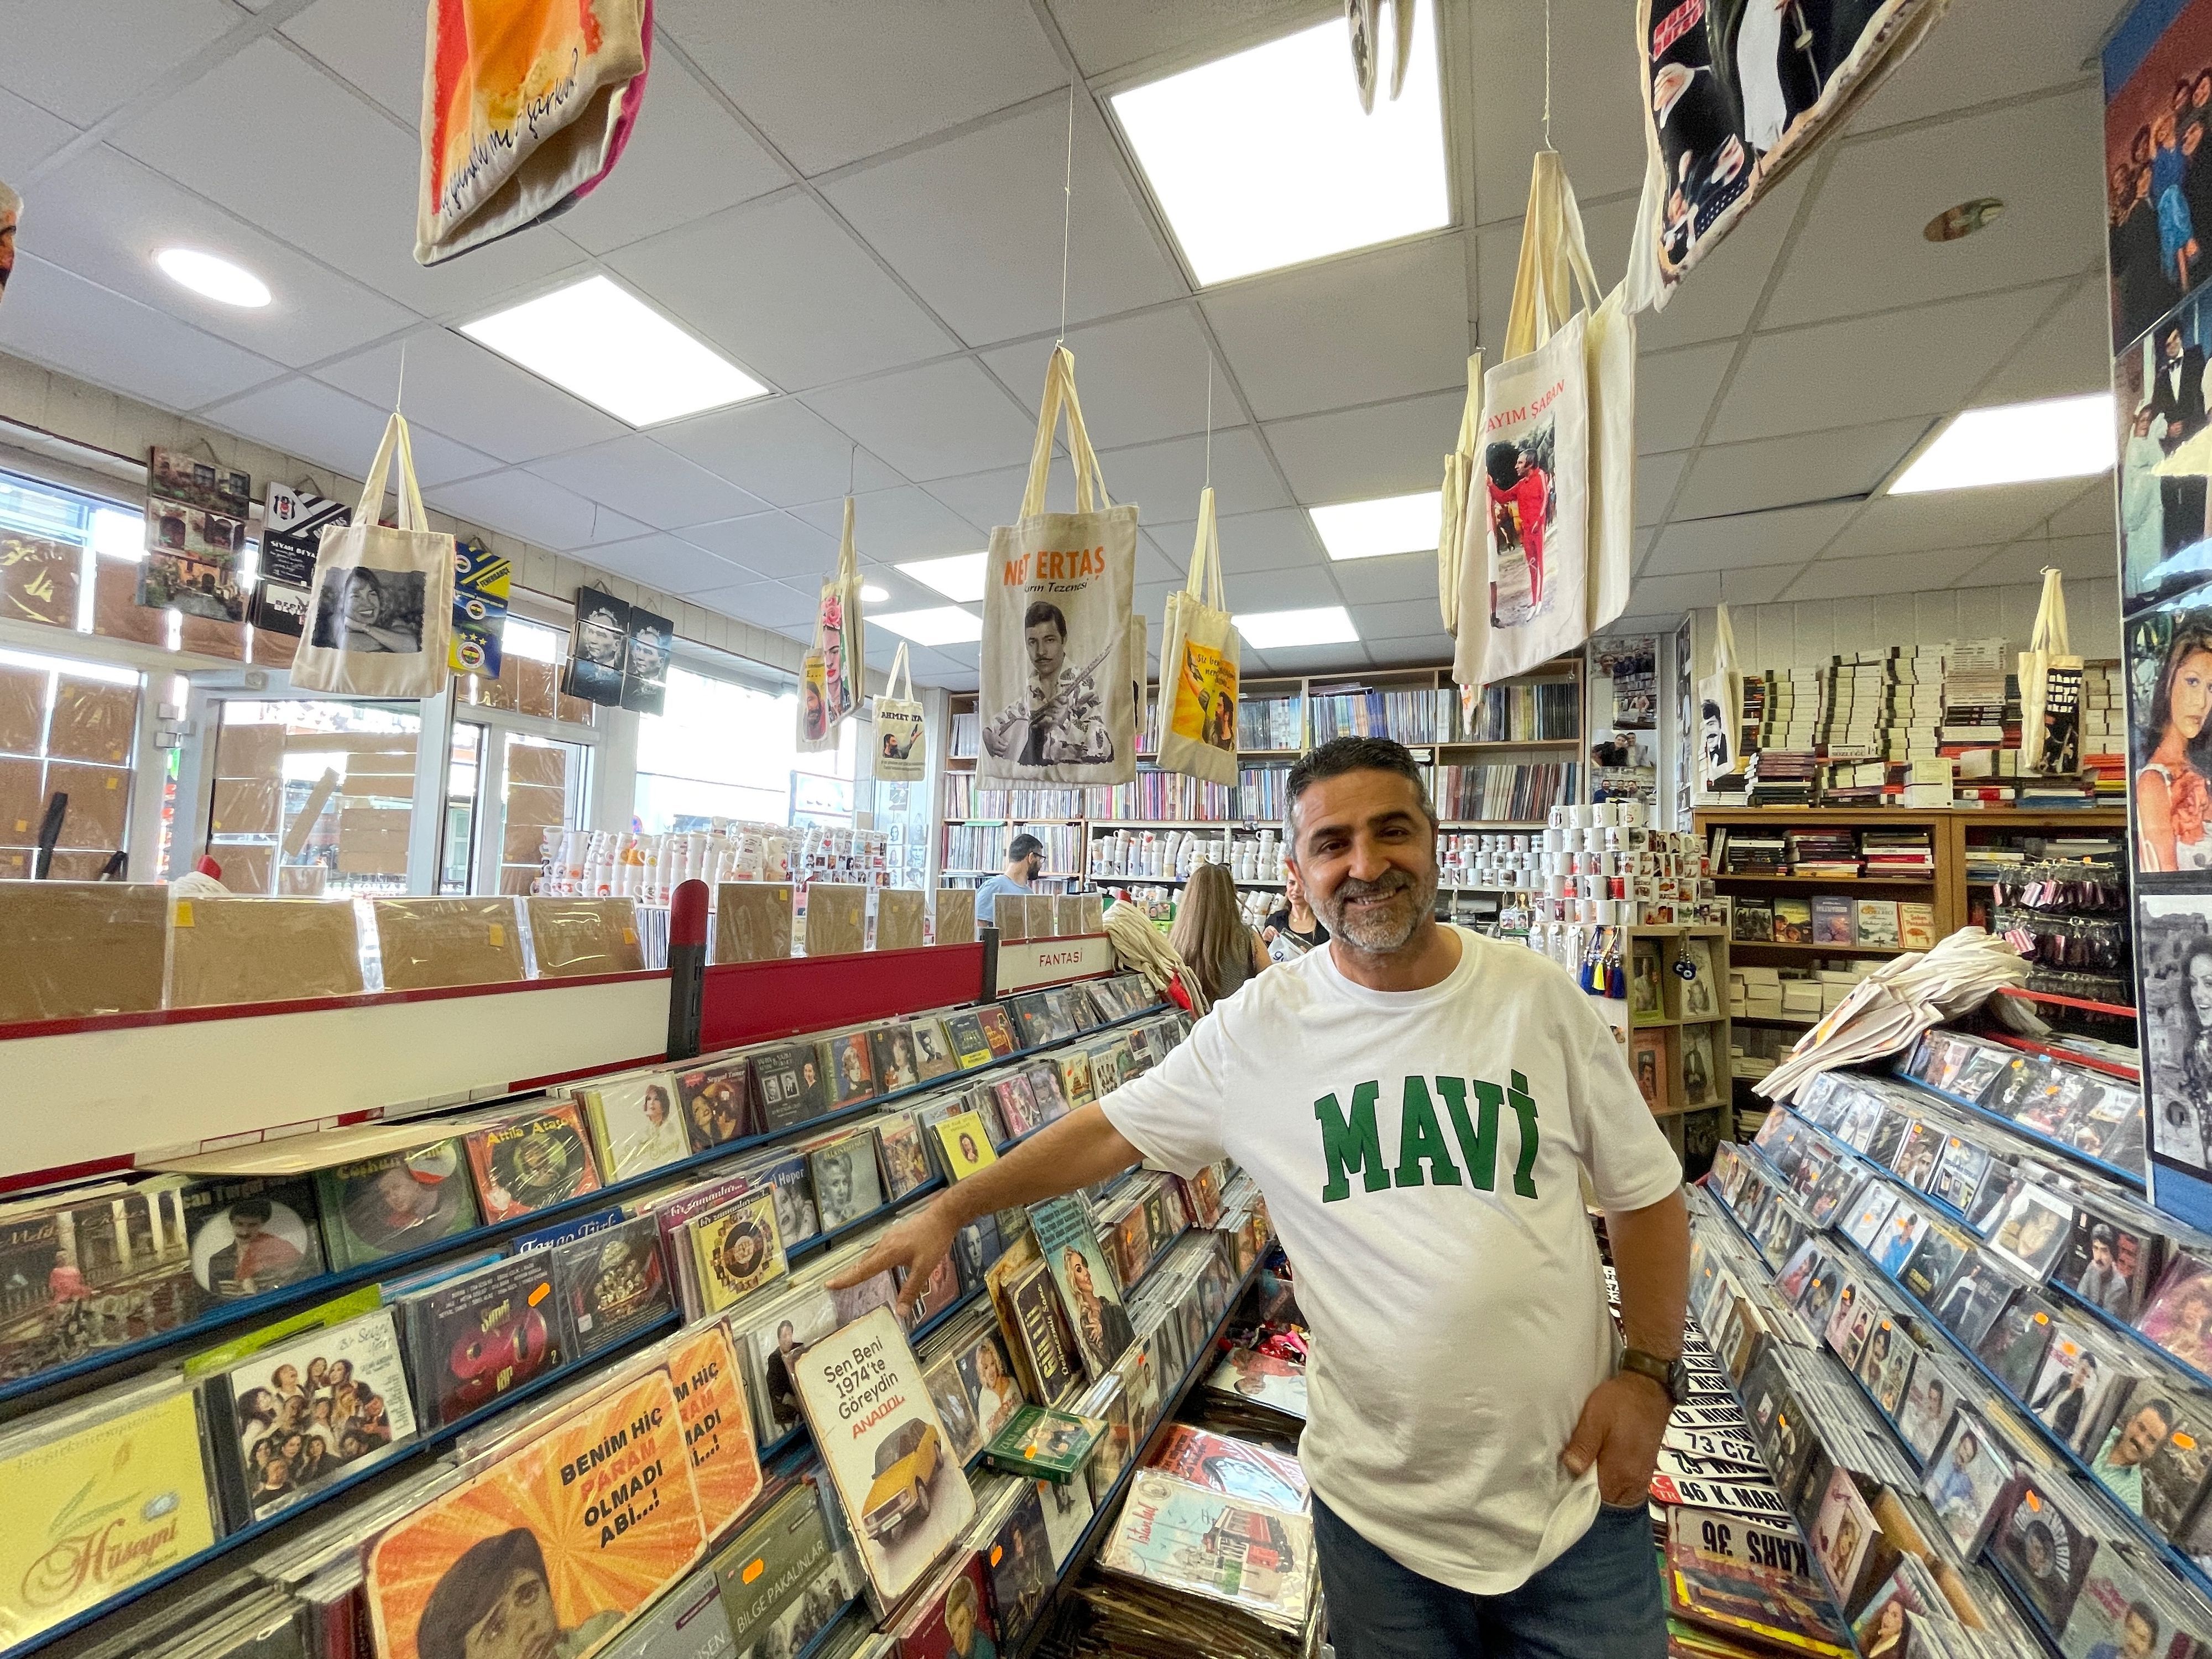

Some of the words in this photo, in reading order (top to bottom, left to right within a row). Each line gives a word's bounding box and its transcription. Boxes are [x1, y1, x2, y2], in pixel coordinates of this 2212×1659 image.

[1531, 379, 1565, 420] ŞABAN
[296, 547, 316, 559] BEYA
[1036, 546, 1105, 581] ERTAŞ
[1048, 578, 1089, 592] Tezenesi
[881, 712, 909, 721] AHMET
[1039, 948, 1083, 967] FANTASİ
[487, 1126, 524, 1147] Attila
[824, 1358, 853, 1384] Sen
[852, 1335, 884, 1365] Beni
[1024, 1305, 1058, 1379] GÜLLÜ
[692, 1362, 719, 1390] HİÇ
[835, 1358, 885, 1399] 1974'te
[838, 1371, 898, 1420] Göreydin
[852, 1394, 905, 1439] ANADOL
[560, 1430, 628, 1486] BENİM
[631, 1407, 663, 1439] HİÇ
[1684, 1432, 1715, 1454] 73
[581, 1437, 656, 1503] PARAM
[584, 1459, 663, 1527] OLMADI
[1657, 1489, 1679, 1501] TR
[1679, 1481, 1708, 1503] 46
[1702, 1520, 1733, 1557] 36
[1745, 1530, 1810, 1578] KARS
[767, 1540, 824, 1603] PAKALINLAR
